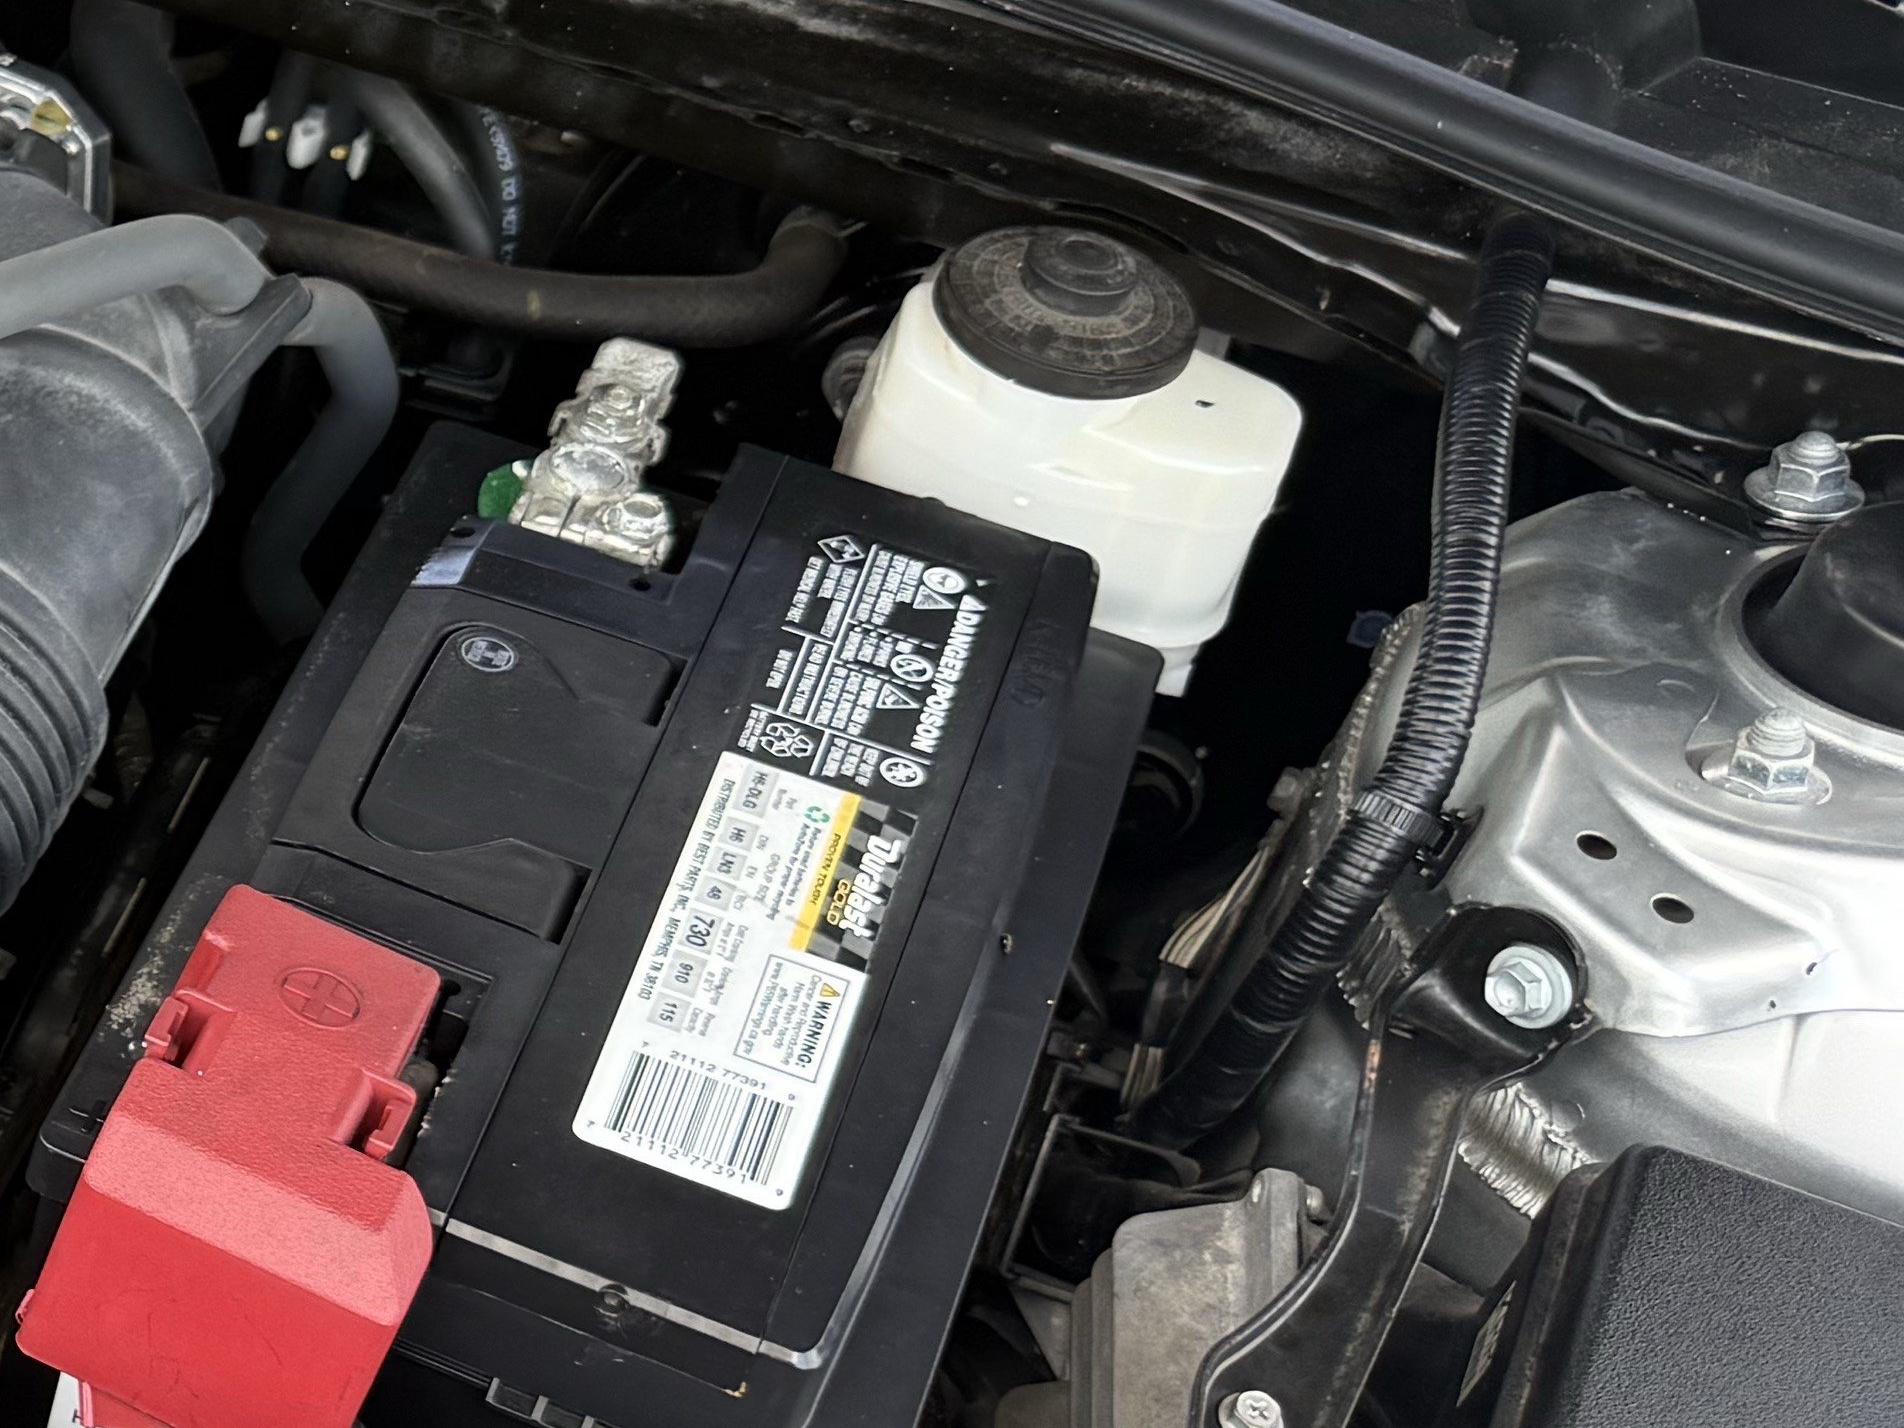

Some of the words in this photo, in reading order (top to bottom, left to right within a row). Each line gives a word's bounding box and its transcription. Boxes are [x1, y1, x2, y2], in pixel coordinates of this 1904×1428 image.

[908, 606, 983, 756] DANGER/POISON
[690, 841, 711, 866] BEST
[726, 825, 747, 845] H6
[819, 831, 842, 871] PROVEN
[714, 850, 738, 876] LN3
[758, 851, 782, 886] GROUP
[751, 882, 771, 905] SIZE
[807, 871, 828, 906] TOUGH
[822, 876, 853, 927] GOLD
[835, 829, 905, 941] Duralast
[681, 911, 717, 950] 730
[672, 960, 696, 986] 910
[657, 999, 681, 1025] 115
[793, 997, 833, 1070] WARNING:
[667, 1048, 717, 1074] 21112
[719, 1067, 768, 1092] 77391
[619, 1129, 680, 1160] 21112
[688, 1153, 749, 1185] 77391
